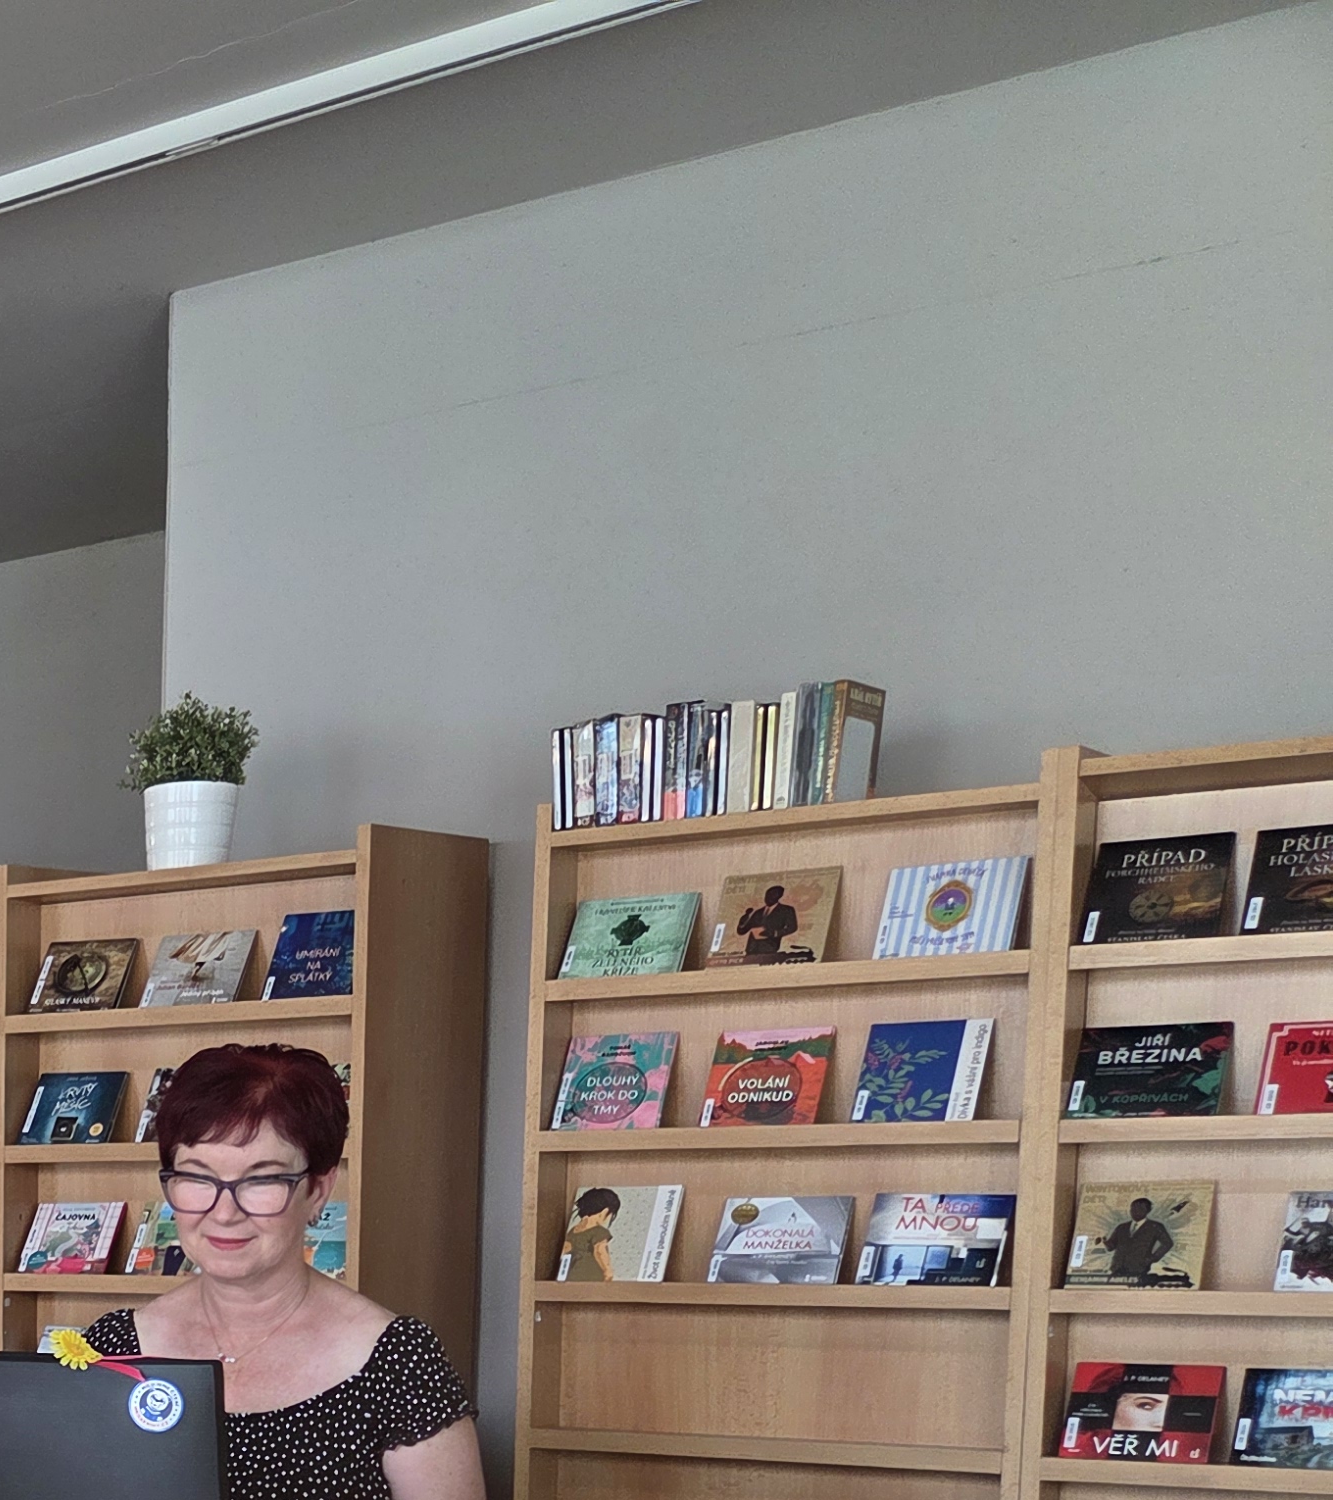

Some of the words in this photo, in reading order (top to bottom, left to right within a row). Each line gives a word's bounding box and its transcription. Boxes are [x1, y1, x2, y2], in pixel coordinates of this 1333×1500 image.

[1122, 848, 1206, 868] PŘÍPAD
[1269, 850, 1333, 866] HOLAS
[306, 961, 321, 970] NA
[1135, 1033, 1171, 1047] JIŘÍ
[1097, 1047, 1203, 1065] BŘEZINA
[587, 1073, 639, 1088] DLOUHÝ
[738, 1075, 790, 1089] VOLÁNÍ
[580, 1090, 615, 1101] KROK
[618, 1090, 638, 1100] DO
[728, 1090, 793, 1103] ODNIKUD
[593, 1105, 620, 1115] TMY
[902, 1197, 926, 1213] TA
[935, 1202, 981, 1214] PŘEDE
[55, 1212, 96, 1221] ČAJOVNA
[895, 1215, 979, 1231] MNOU
[745, 1228, 815, 1238] DOKONALÁ
[743, 1240, 812, 1250] MANŽELKA
[1093, 1433, 1139, 1456] VĚŘ
[1145, 1438, 1180, 1457] MI
